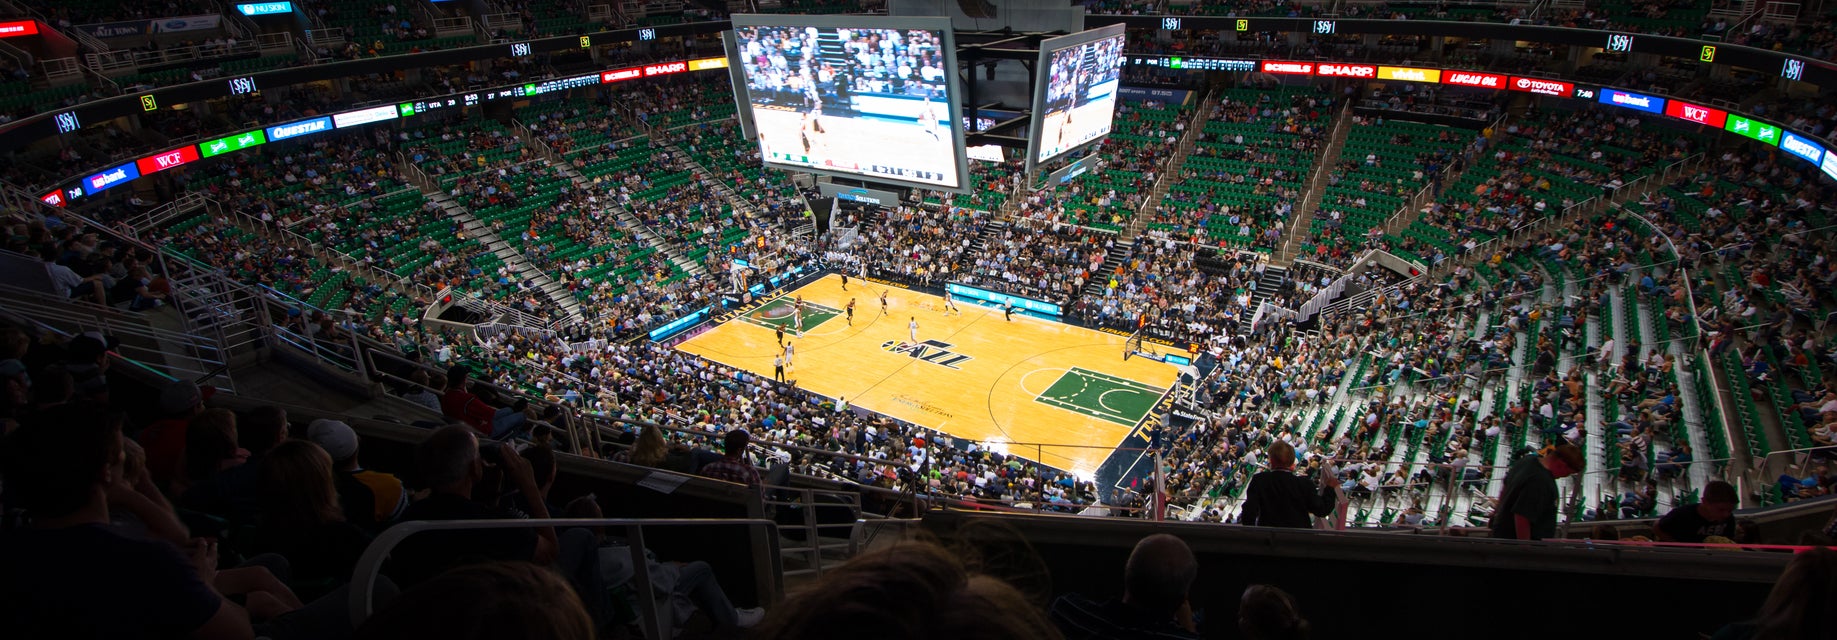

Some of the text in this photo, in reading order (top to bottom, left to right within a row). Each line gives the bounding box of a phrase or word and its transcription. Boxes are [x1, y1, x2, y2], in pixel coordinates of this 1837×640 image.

[646, 63, 685, 75] SHARP
[1318, 64, 1371, 77] SHARP
[1450, 73, 1498, 87] LUCAS OIL
[1531, 80, 1564, 92] TOYOTA
[1577, 89, 1593, 99] 7:40
[1684, 105, 1708, 121] WCF
[273, 120, 326, 139] QUESTAR
[156, 152, 181, 167] WCF
[69, 188, 83, 199] 7:40
[714, 304, 755, 323] UTAH
[756, 288, 788, 306] JAZZ
